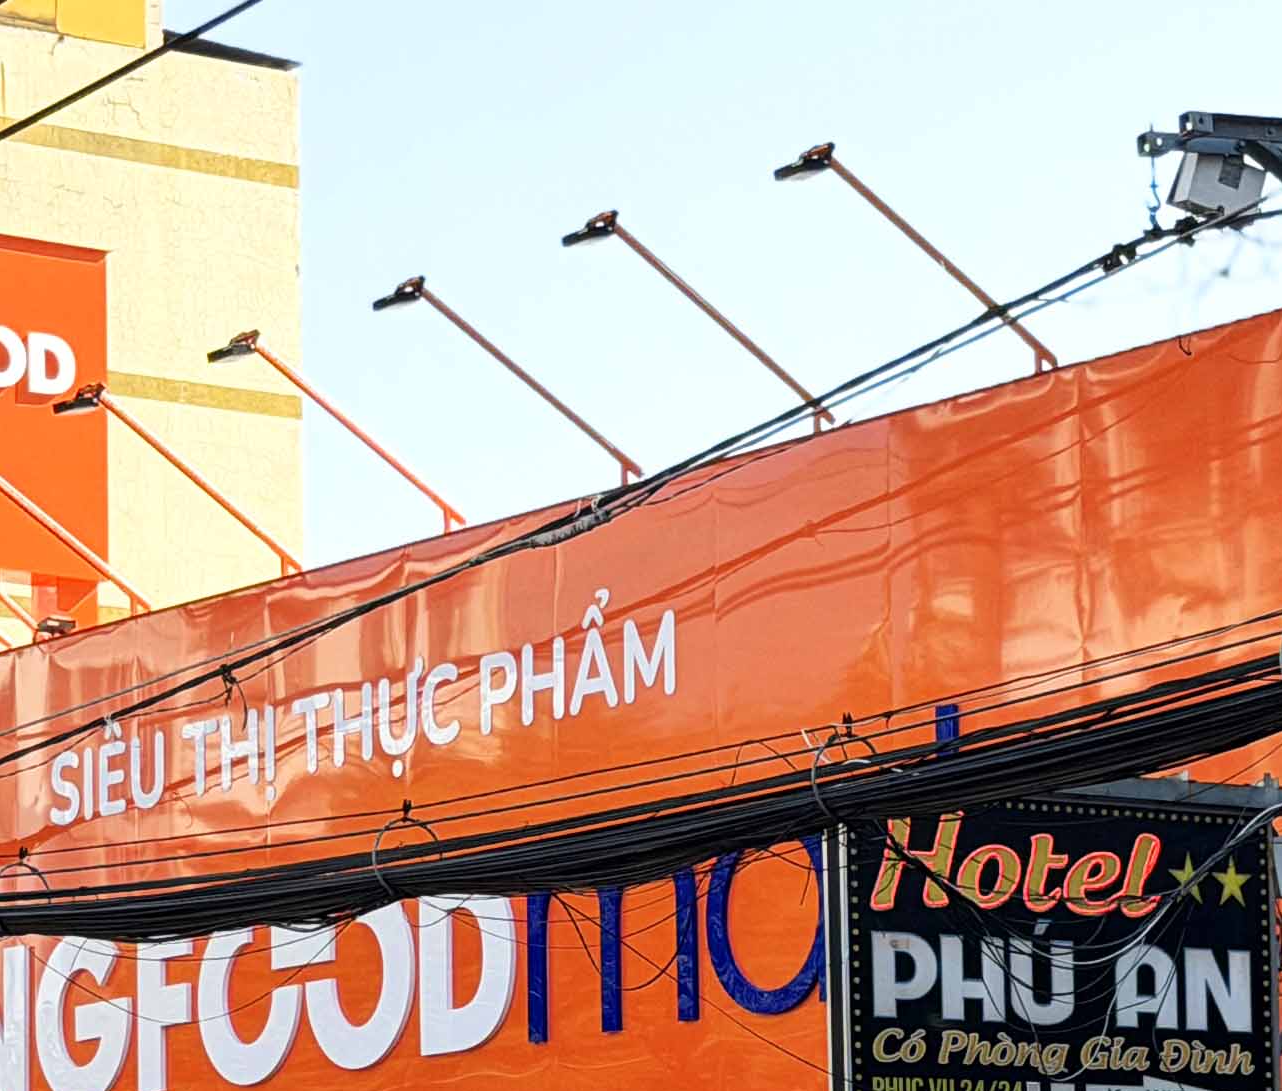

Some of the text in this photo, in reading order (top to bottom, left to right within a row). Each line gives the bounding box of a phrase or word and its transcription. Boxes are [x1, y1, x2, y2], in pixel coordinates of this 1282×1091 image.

[49, 588, 676, 826] SIÊU THỊ THỰC PHẨM
[869, 810, 1164, 918] Hotel
[870, 918, 1254, 1034] PHÚ AN
[872, 1027, 1256, 1077] Có Phòng Gia Đình
